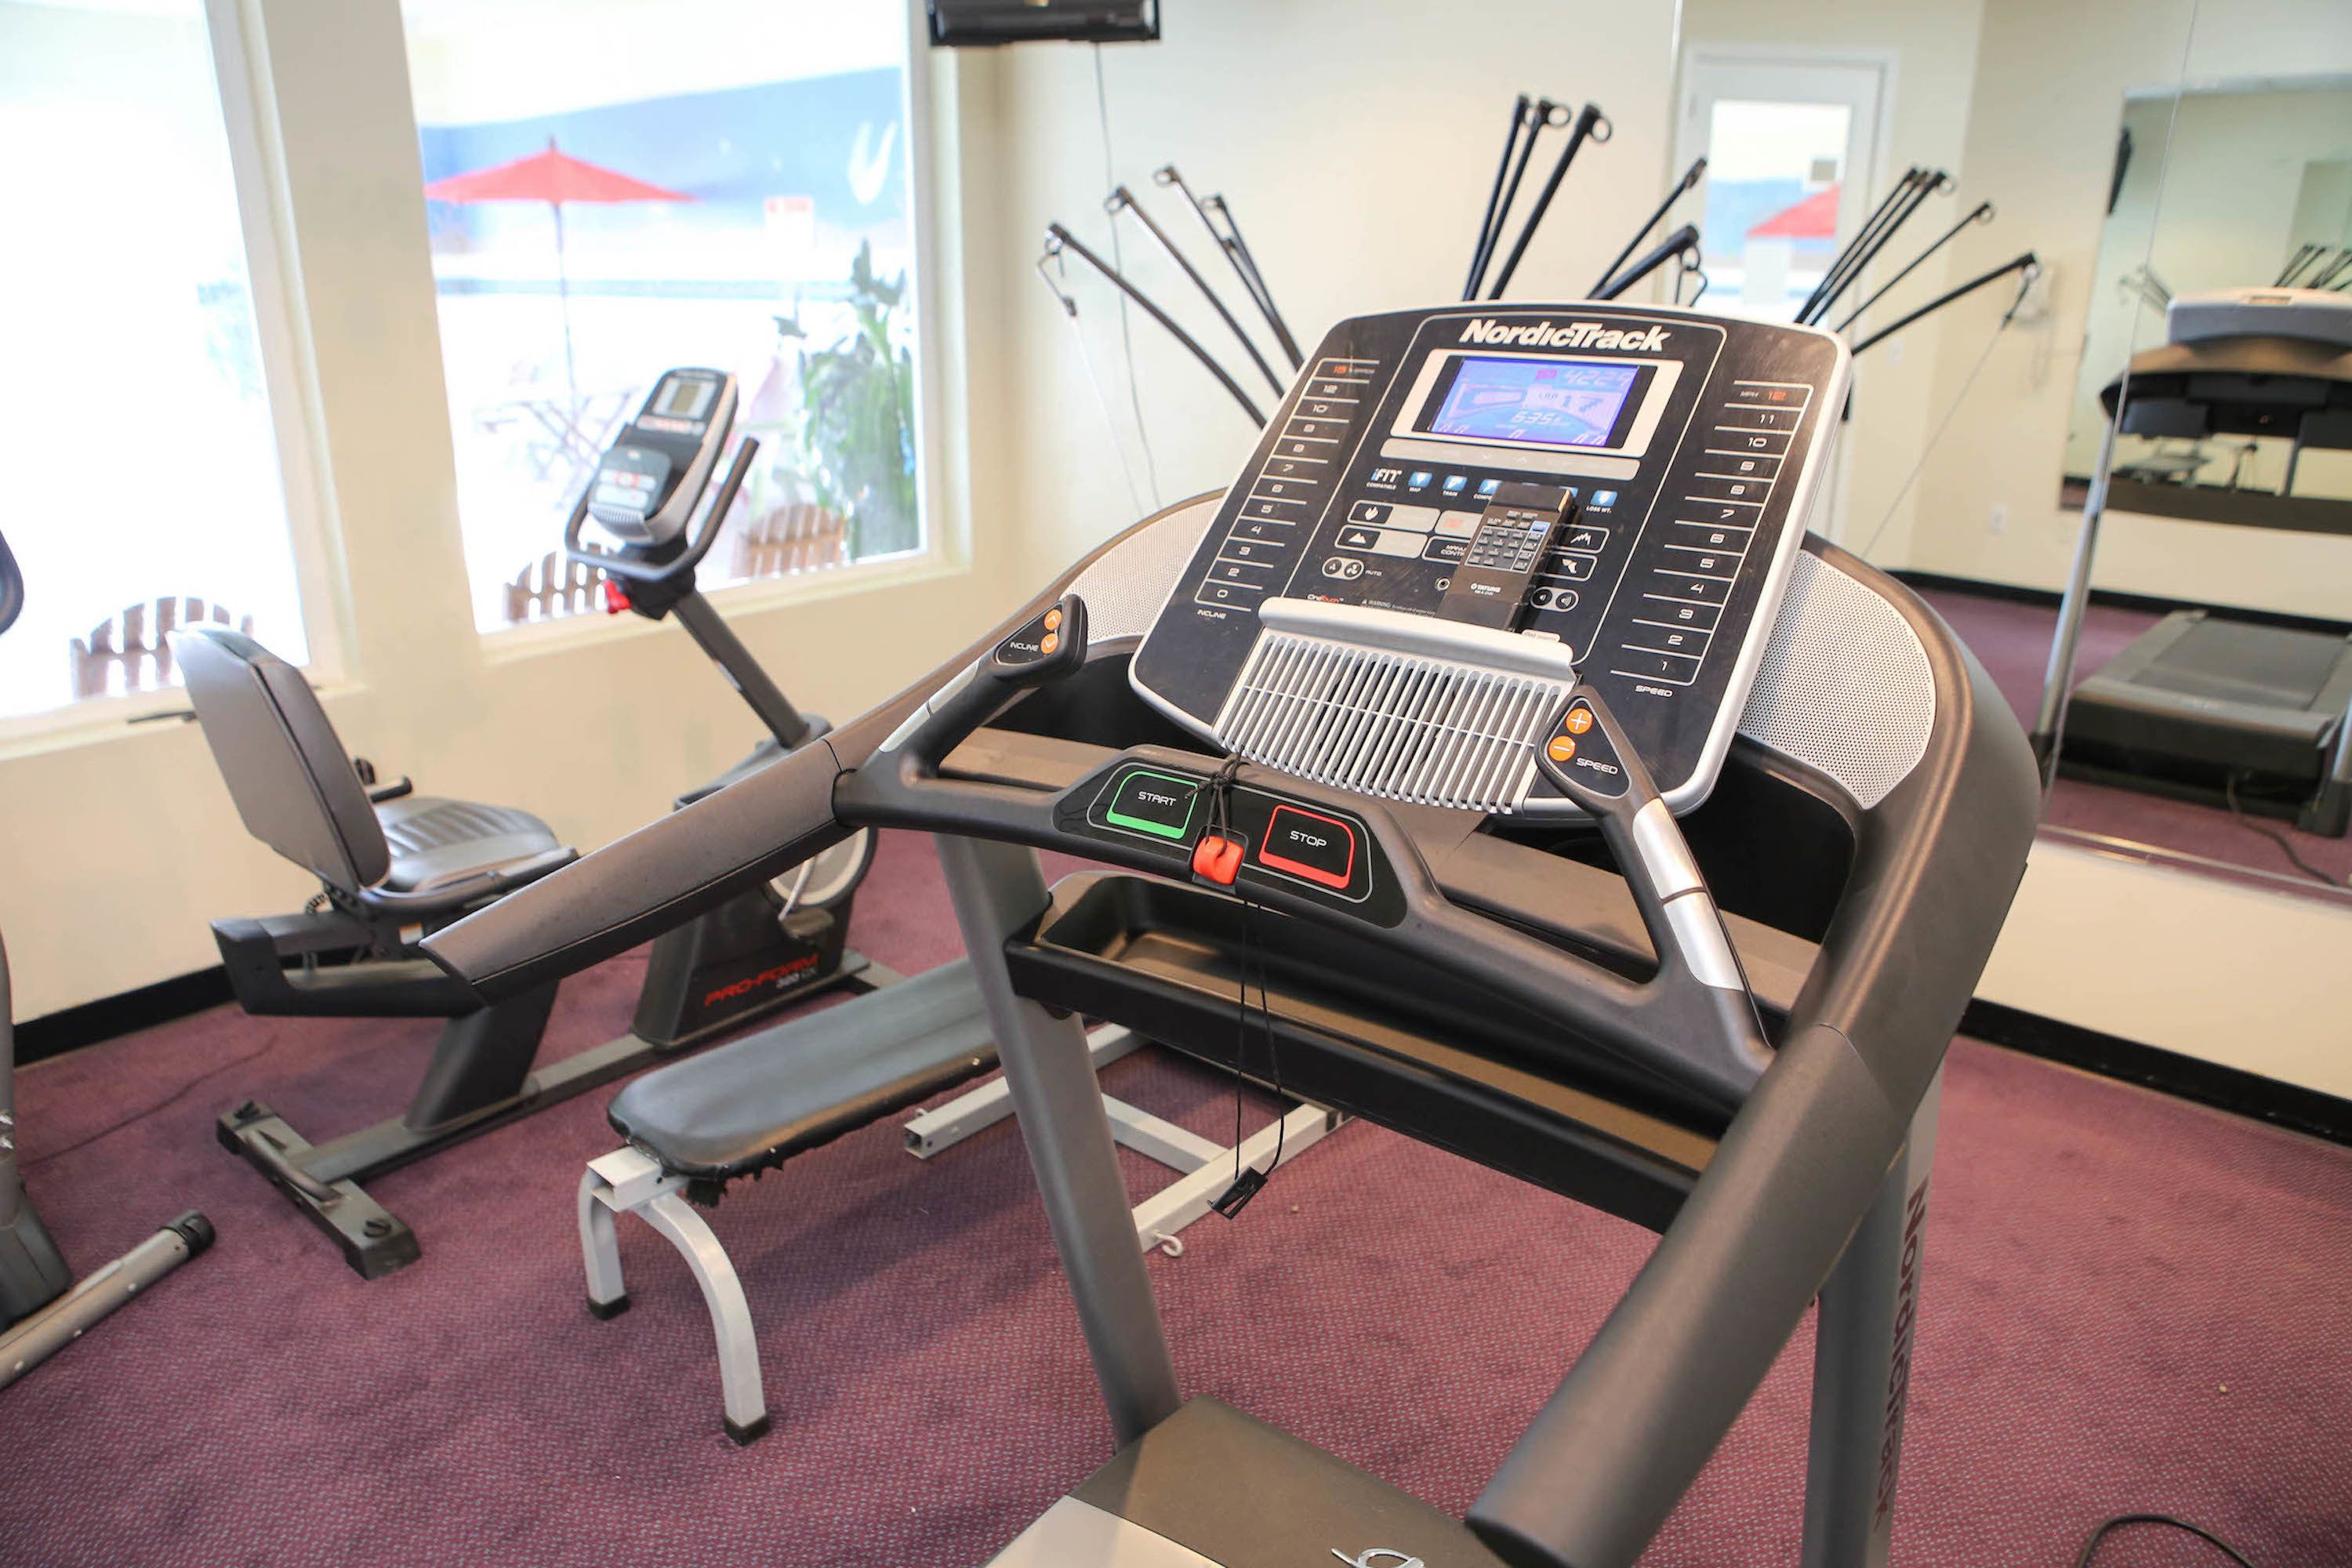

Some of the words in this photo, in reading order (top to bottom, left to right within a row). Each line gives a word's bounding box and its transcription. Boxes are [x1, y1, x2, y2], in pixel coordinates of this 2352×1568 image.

[1459, 318, 1671, 352] NordicTrack
[1312, 404, 1329, 414] 10
[1759, 413, 1776, 425] 11
[1747, 436, 1768, 448] 10
[1283, 463, 1294, 473] 7
[1260, 504, 1273, 514] 5
[1720, 509, 1736, 518] 7
[1250, 524, 1263, 535] 4
[1699, 557, 1716, 569] 5
[1226, 567, 1240, 577] 2
[1216, 589, 1229, 599] 0
[1690, 583, 1705, 594] 4
[1196, 608, 1227, 620] INCLINE
[1678, 608, 1694, 620] 3
[1667, 634, 1684, 646] 2
[1010, 641, 1040, 652] INCLINE
[1661, 660, 1668, 671] 1
[1635, 684, 1673, 698] SPEED
[1576, 757, 1619, 775] SPEED
[1137, 790, 1177, 808] START
[1289, 829, 1327, 848] STOP
[1873, 1174, 1929, 1532] NordicTrack
